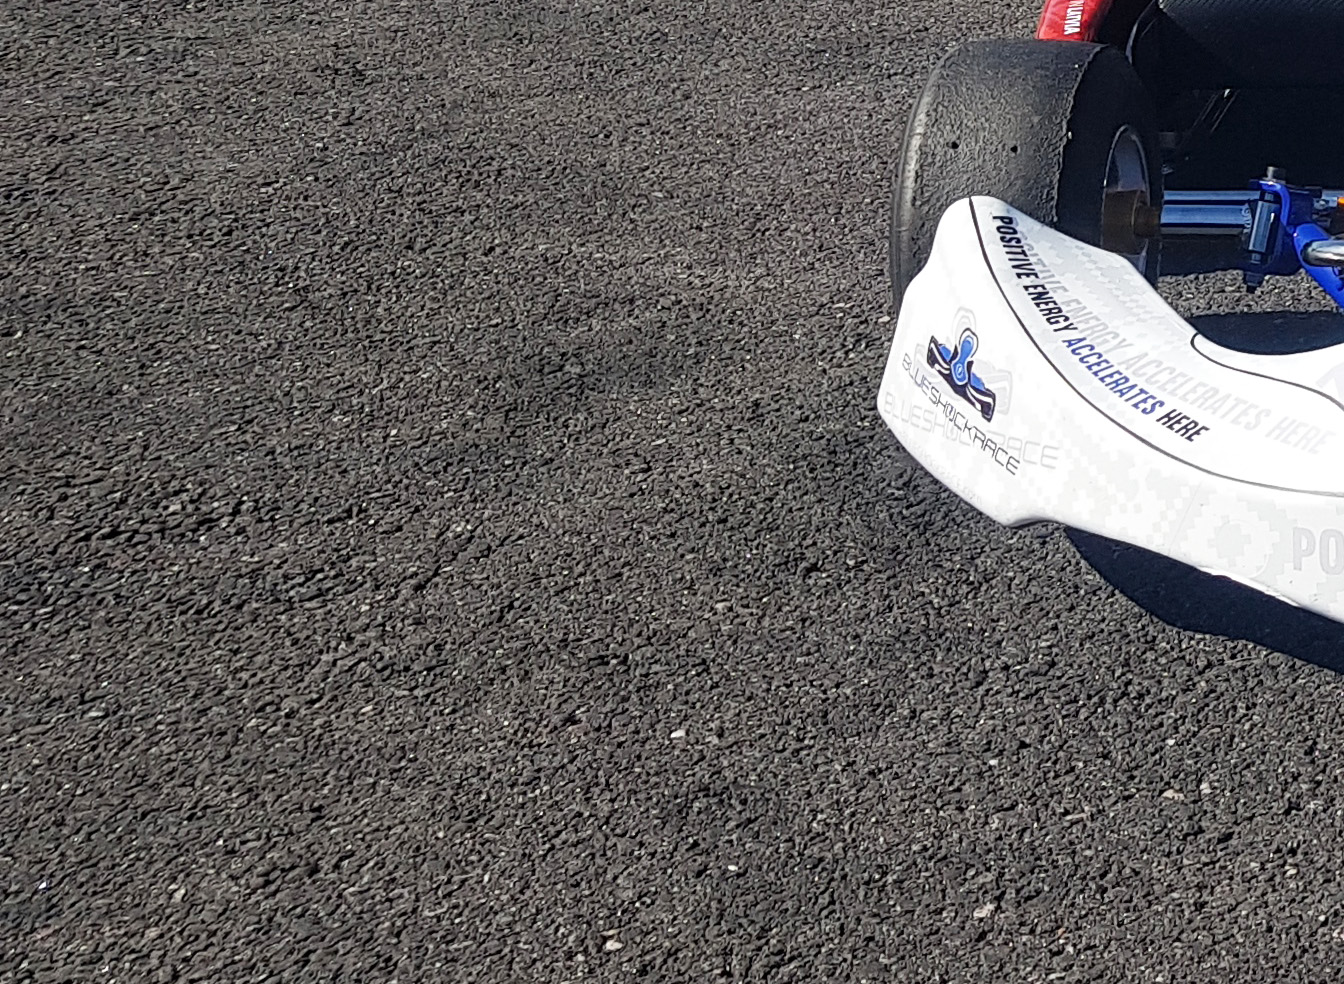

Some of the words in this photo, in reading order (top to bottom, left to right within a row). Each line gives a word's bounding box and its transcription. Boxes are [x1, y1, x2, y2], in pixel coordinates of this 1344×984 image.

[901, 353, 1020, 476] BLUESHOCKRACE
[992, 215, 1039, 280] POSITIVE
[1023, 284, 1078, 333] ENERGY
[1061, 336, 1166, 415] ACCELERATES
[1155, 408, 1211, 443] HERE
